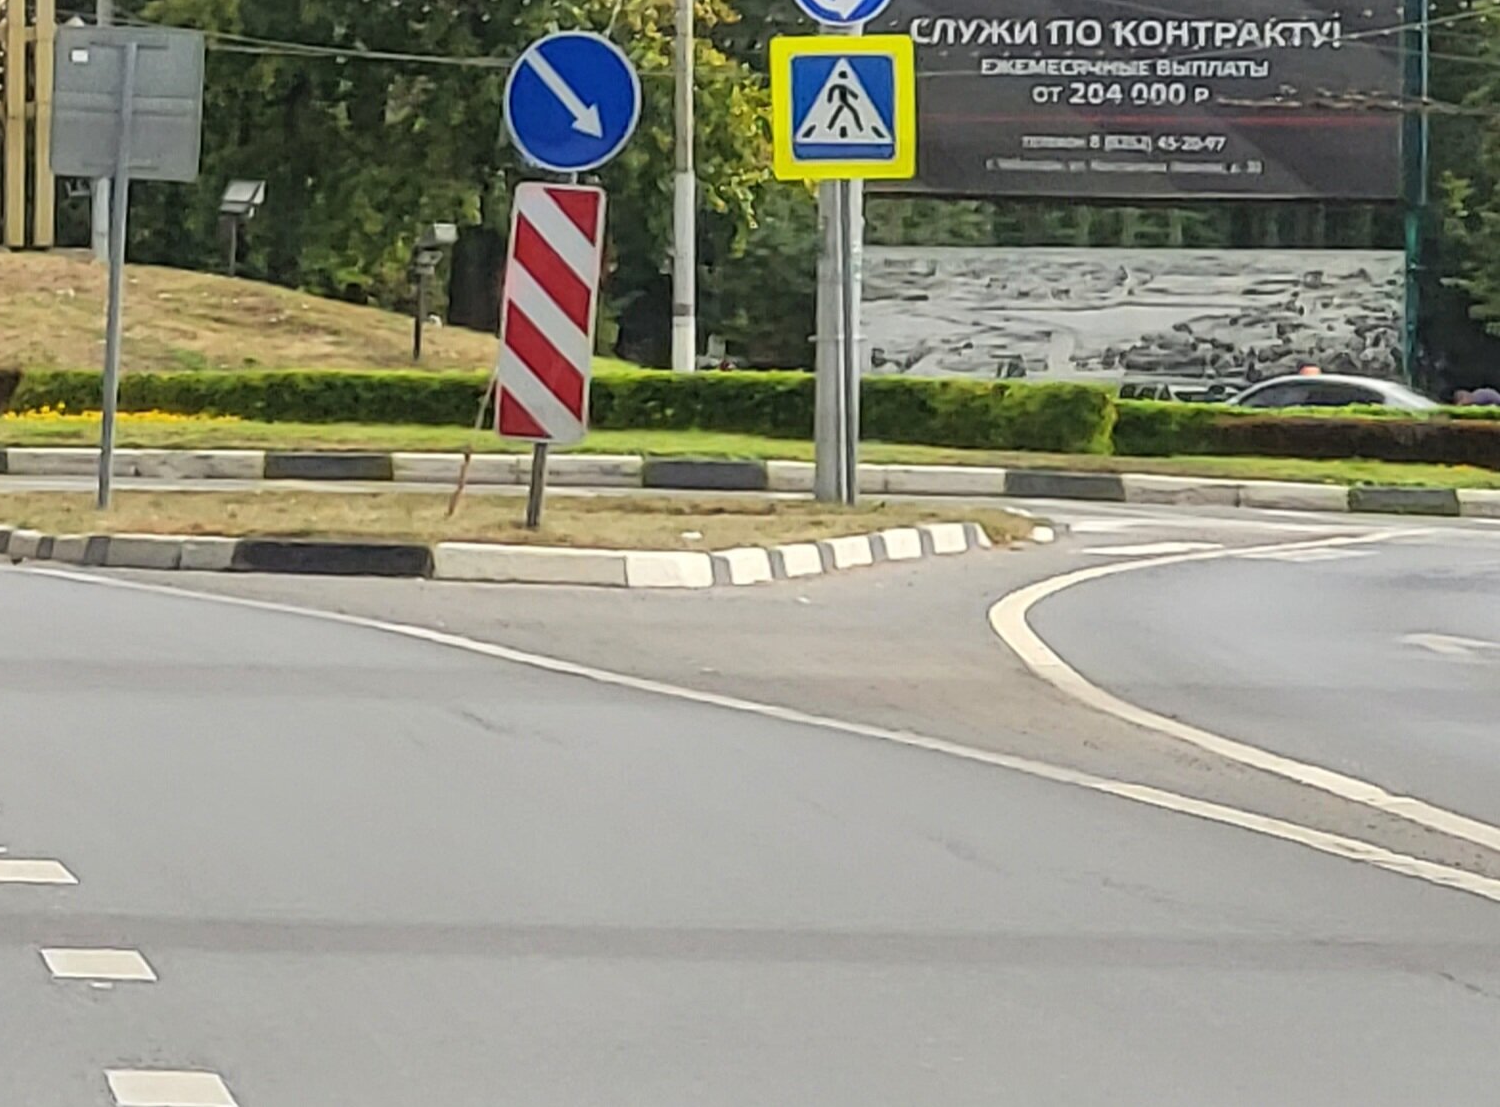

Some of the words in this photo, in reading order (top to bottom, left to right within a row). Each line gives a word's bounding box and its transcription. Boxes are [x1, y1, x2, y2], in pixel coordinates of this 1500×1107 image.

[910, 18, 1038, 45] СЛУЖИ
[1048, 20, 1102, 46] ПО
[1113, 20, 1342, 48] КОНТРАКТУ!
[981, 58, 1150, 76] ЕЖЕМЕСЯЧНЫЕ
[1156, 60, 1269, 77] ВЫПЛАТЫ
[1069, 82, 1123, 104] 204
[1130, 83, 1186, 105] 000
